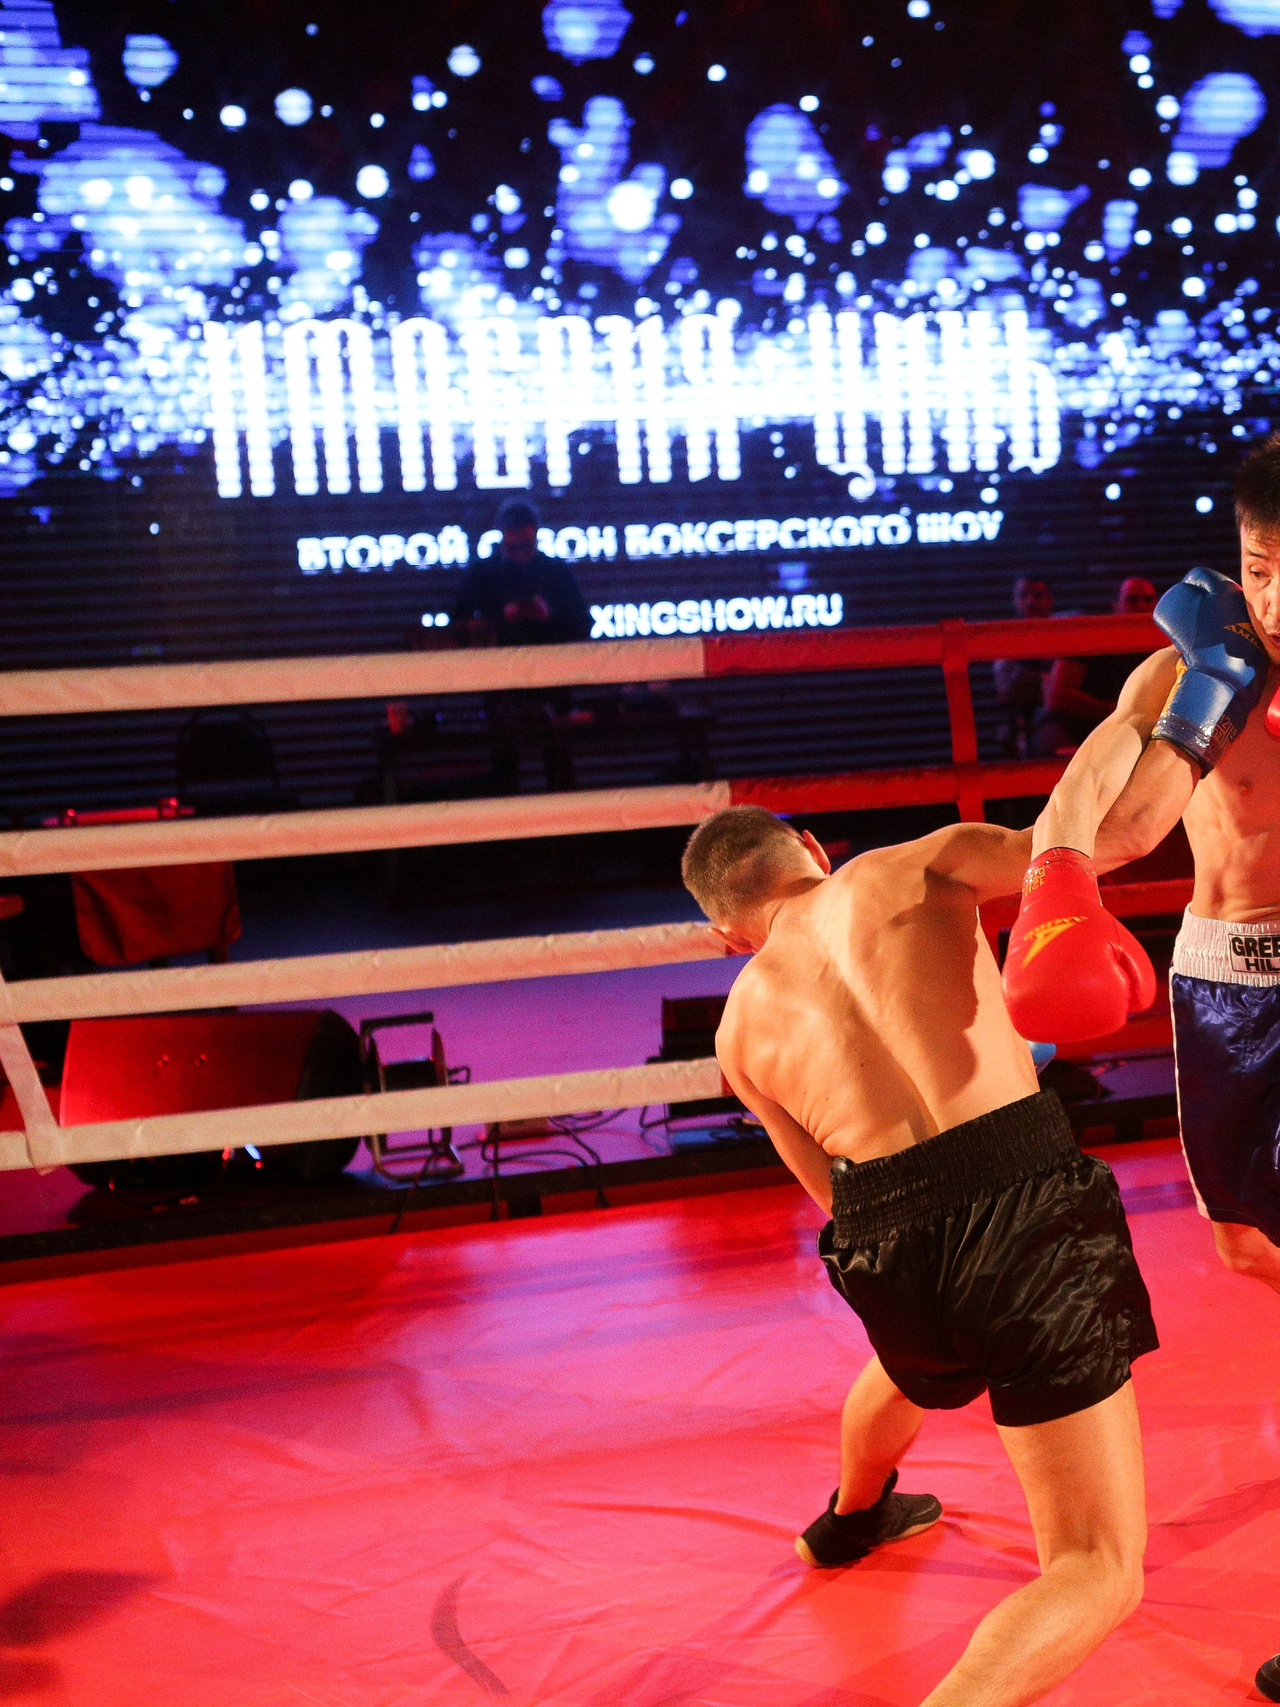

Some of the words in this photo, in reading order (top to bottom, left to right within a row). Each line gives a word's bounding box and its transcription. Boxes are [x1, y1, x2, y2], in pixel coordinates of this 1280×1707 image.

[297, 525, 470, 572] ВТОРОЙ
[477, 524, 618, 562] СЗОН
[624, 514, 913, 557] БОКСЕРСКОГО
[916, 509, 1004, 543] ШОУ
[589, 592, 844, 639] XINGSHOW.RU
